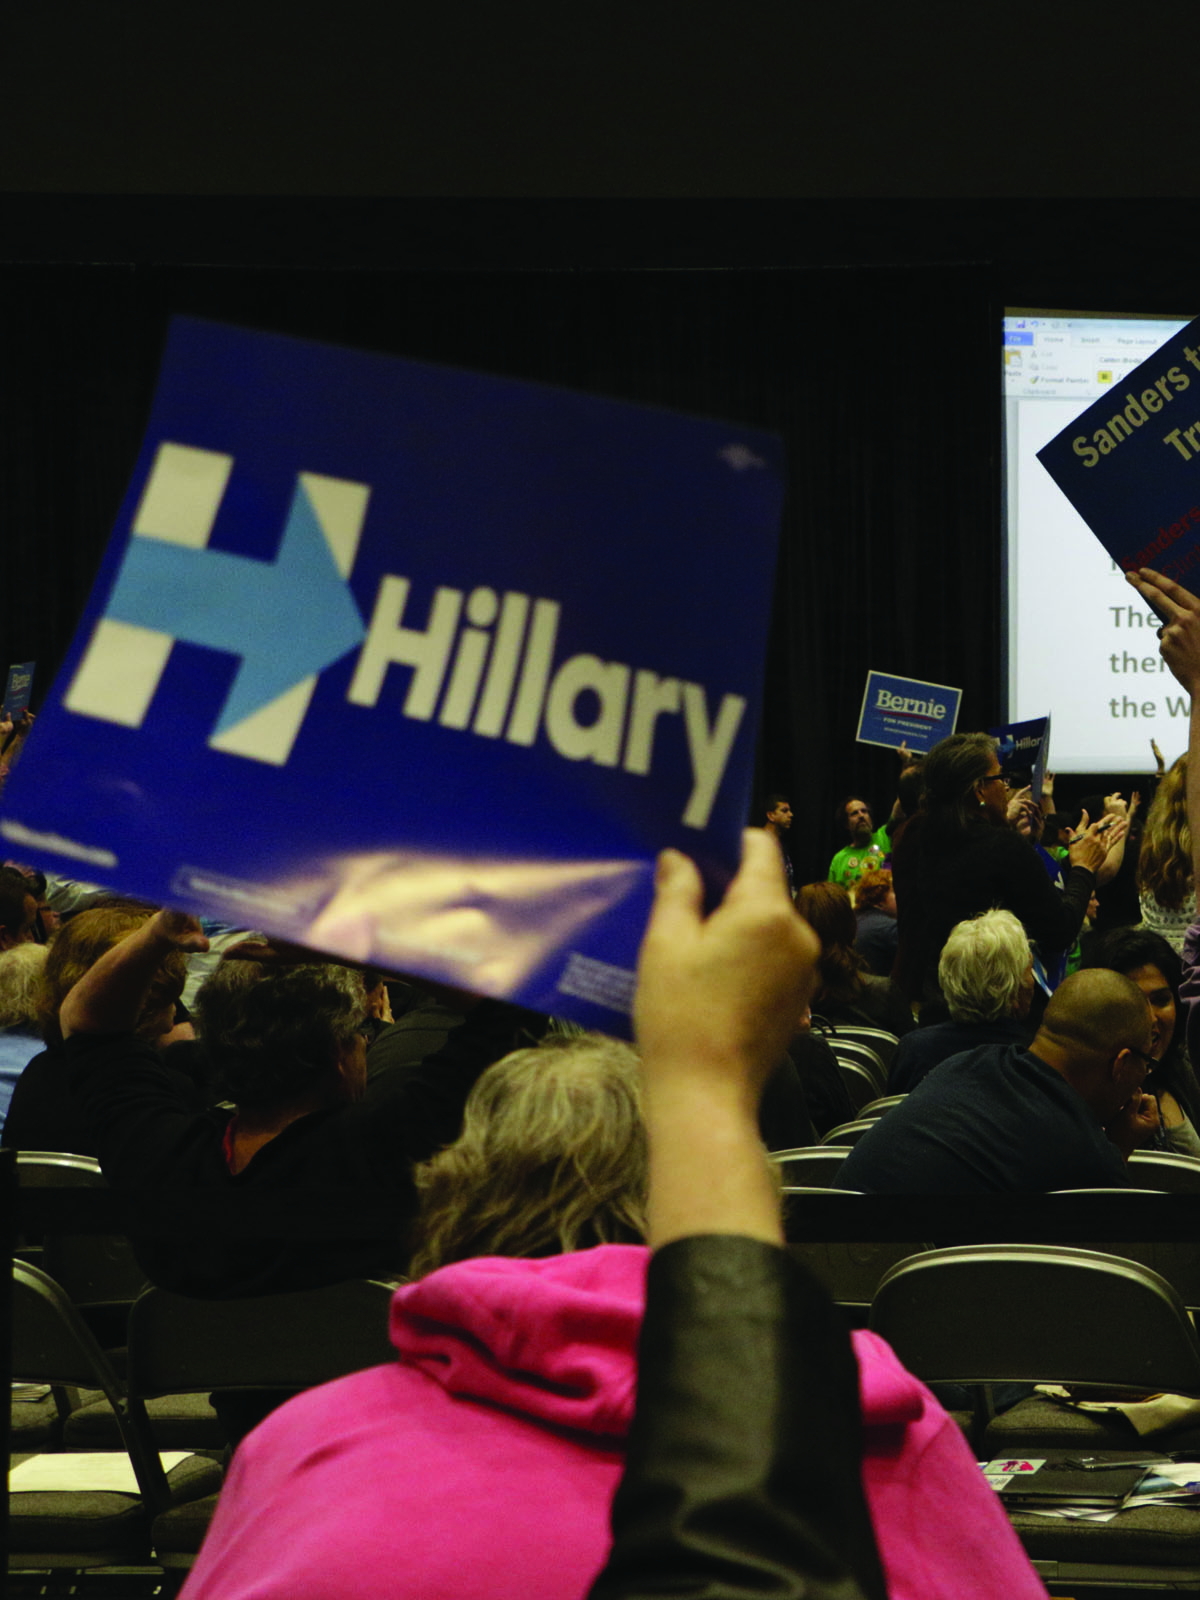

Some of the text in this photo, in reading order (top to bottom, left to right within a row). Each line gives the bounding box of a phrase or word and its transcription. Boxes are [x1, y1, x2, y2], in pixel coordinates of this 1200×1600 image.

[1073, 367, 1189, 467] Sanders
[1108, 605, 1159, 628] The
[345, 573, 747, 831] Hillary
[875, 688, 947, 720] Bernie
[1108, 695, 1157, 718] the
